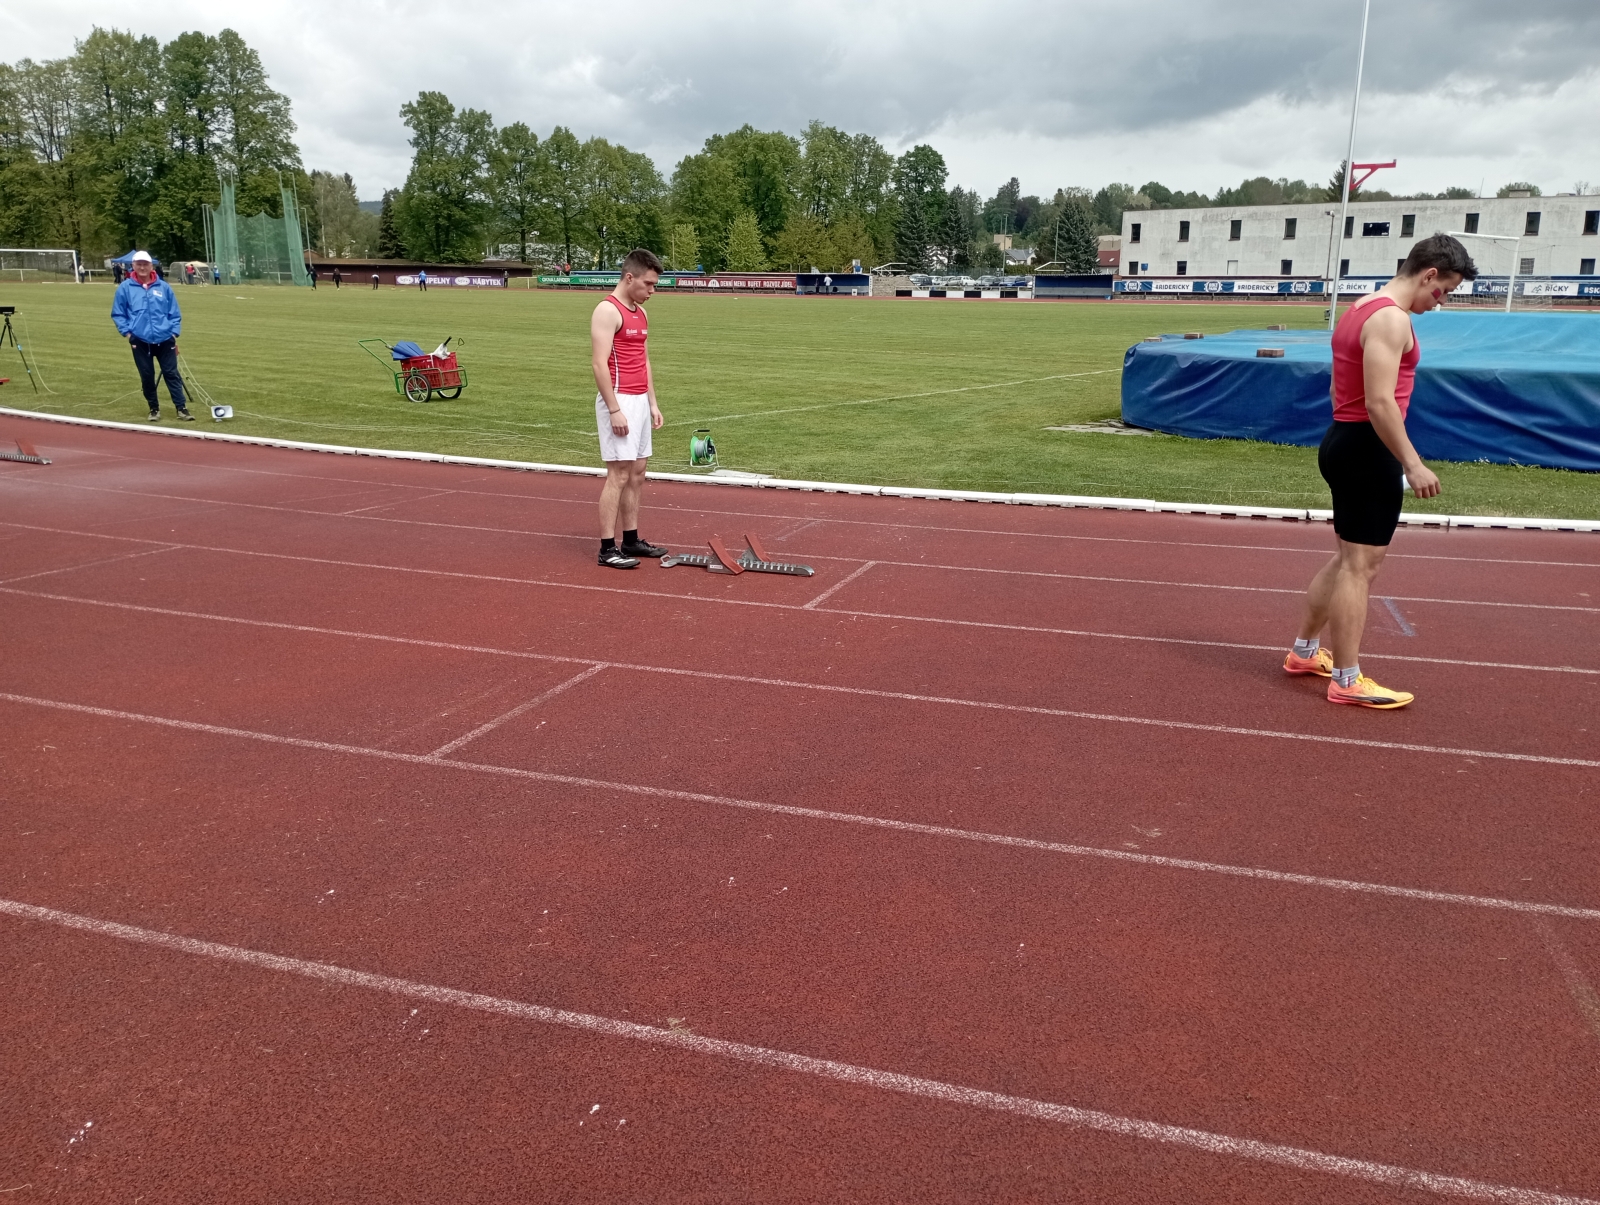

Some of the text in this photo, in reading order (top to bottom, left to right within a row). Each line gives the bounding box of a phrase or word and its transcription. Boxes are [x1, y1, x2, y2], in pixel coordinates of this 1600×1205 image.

[414, 277, 451, 285] KUPELNY
[472, 276, 502, 286] NÁBYTEK
[747, 280, 761, 288] BUFET
